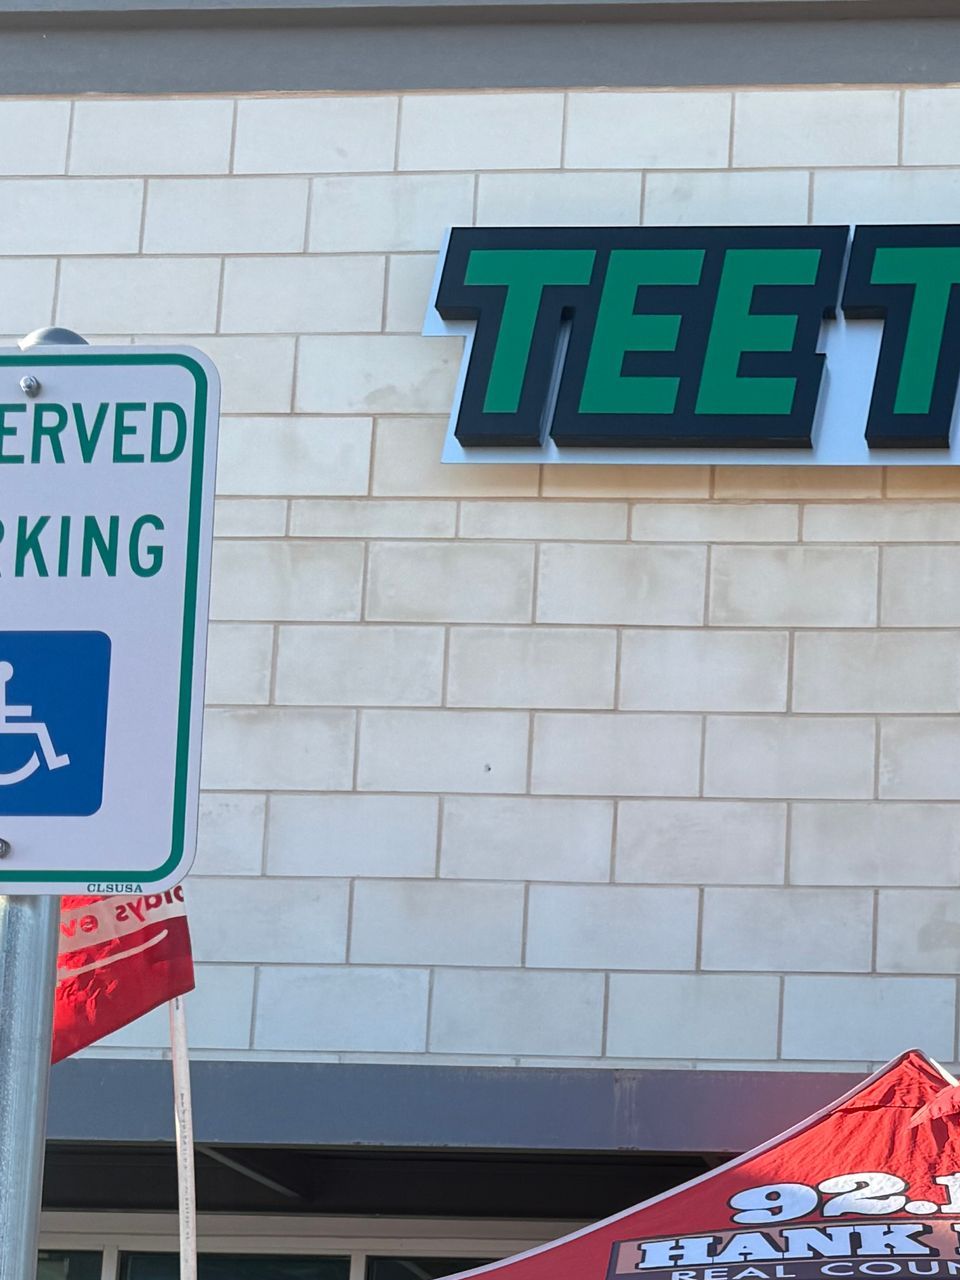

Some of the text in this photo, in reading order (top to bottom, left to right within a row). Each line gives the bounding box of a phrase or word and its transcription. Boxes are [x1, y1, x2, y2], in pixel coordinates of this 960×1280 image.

[463, 247, 822, 415] TEE
[0, 402, 187, 464] ERVED
[0, 514, 164, 578] KING
[87, 883, 143, 893] CLSUSA
[638, 1223, 926, 1270] HANK
